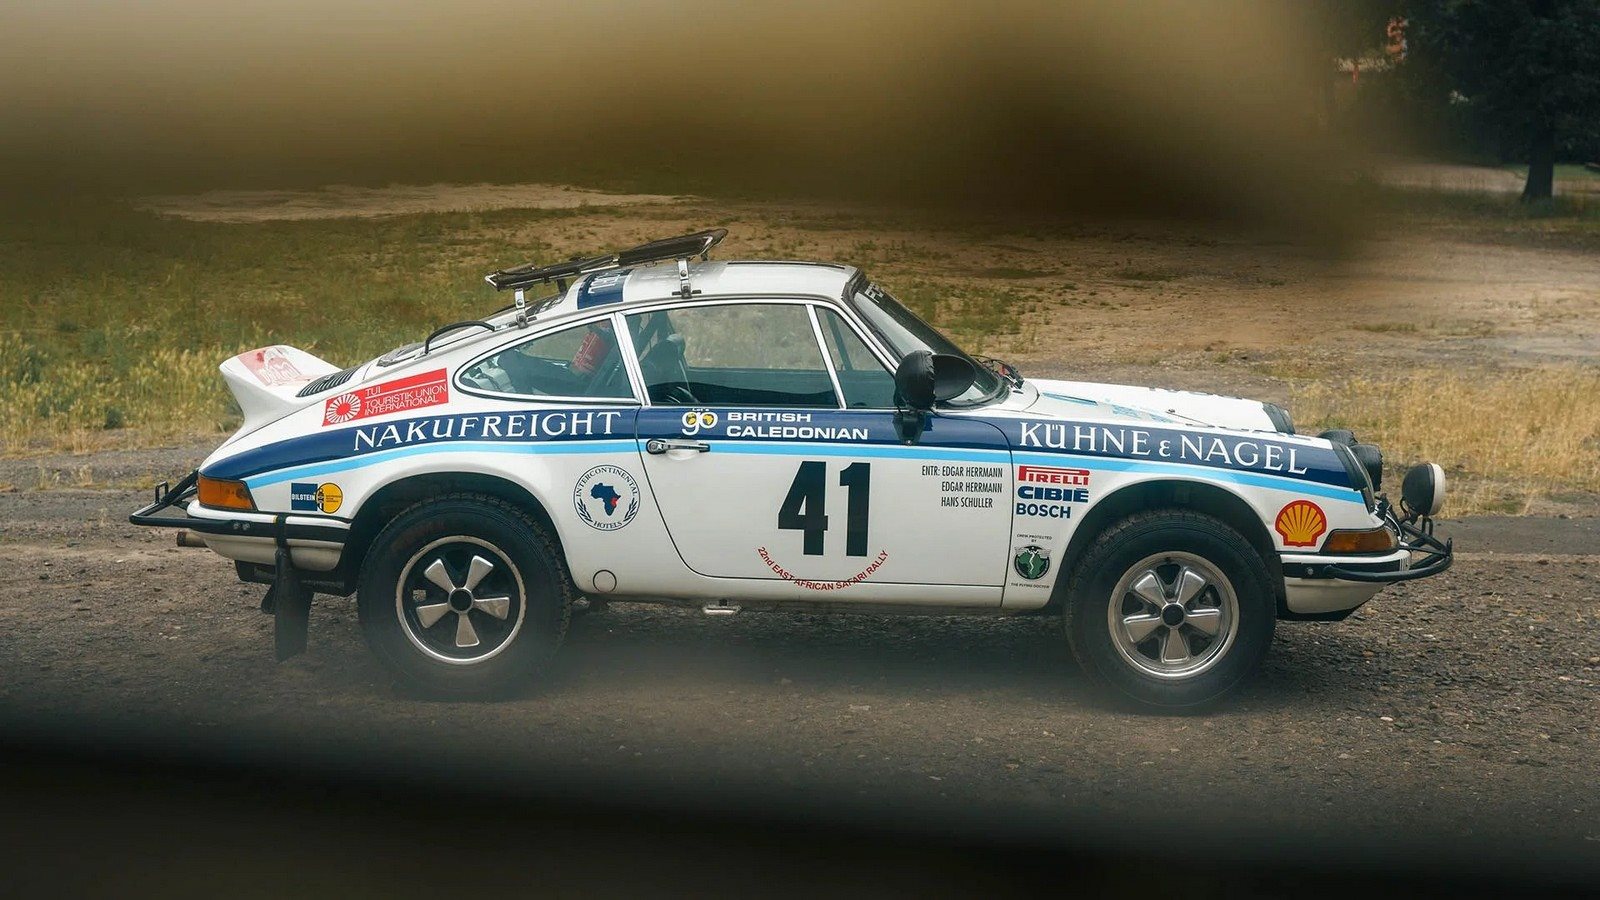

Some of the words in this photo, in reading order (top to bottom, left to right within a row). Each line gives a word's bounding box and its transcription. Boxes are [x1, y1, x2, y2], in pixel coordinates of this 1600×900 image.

[365, 386, 381, 397] TUI
[365, 391, 414, 409] TOURISTIK
[415, 383, 447, 397] UNION
[364, 395, 438, 416] INTERNATIONAL
[681, 411, 718, 436] go
[727, 412, 811, 422] BRITISH
[353, 411, 621, 451] NAKUFREIGHT
[726, 426, 869, 440] CALEDONIAN
[1019, 421, 1151, 456] KÜHNE
[1180, 434, 1307, 475] NAGEL
[921, 465, 940, 477] ENTR:
[942, 466, 964, 477] EDGAR
[965, 466, 1003, 478] HERRMANN
[1018, 465, 1090, 486] PIRELLI
[576, 467, 638, 497] INTERCONTINENTAL
[941, 481, 963, 492] EDGAR
[965, 482, 1002, 493] HERRMANN
[291, 493, 316, 501] BILSTEIN
[941, 497, 958, 507] HANS
[960, 498, 993, 508] SCHULLER
[778, 461, 870, 557] 41
[1016, 502, 1071, 519] BOSCH
[593, 521, 623, 529] HOTELS
[757, 546, 774, 567] 22nd
[771, 564, 795, 581] EAST
[793, 577, 834, 591] AFRICAN
[836, 570, 868, 588] SAFARI
[865, 549, 889, 577] RALLY
